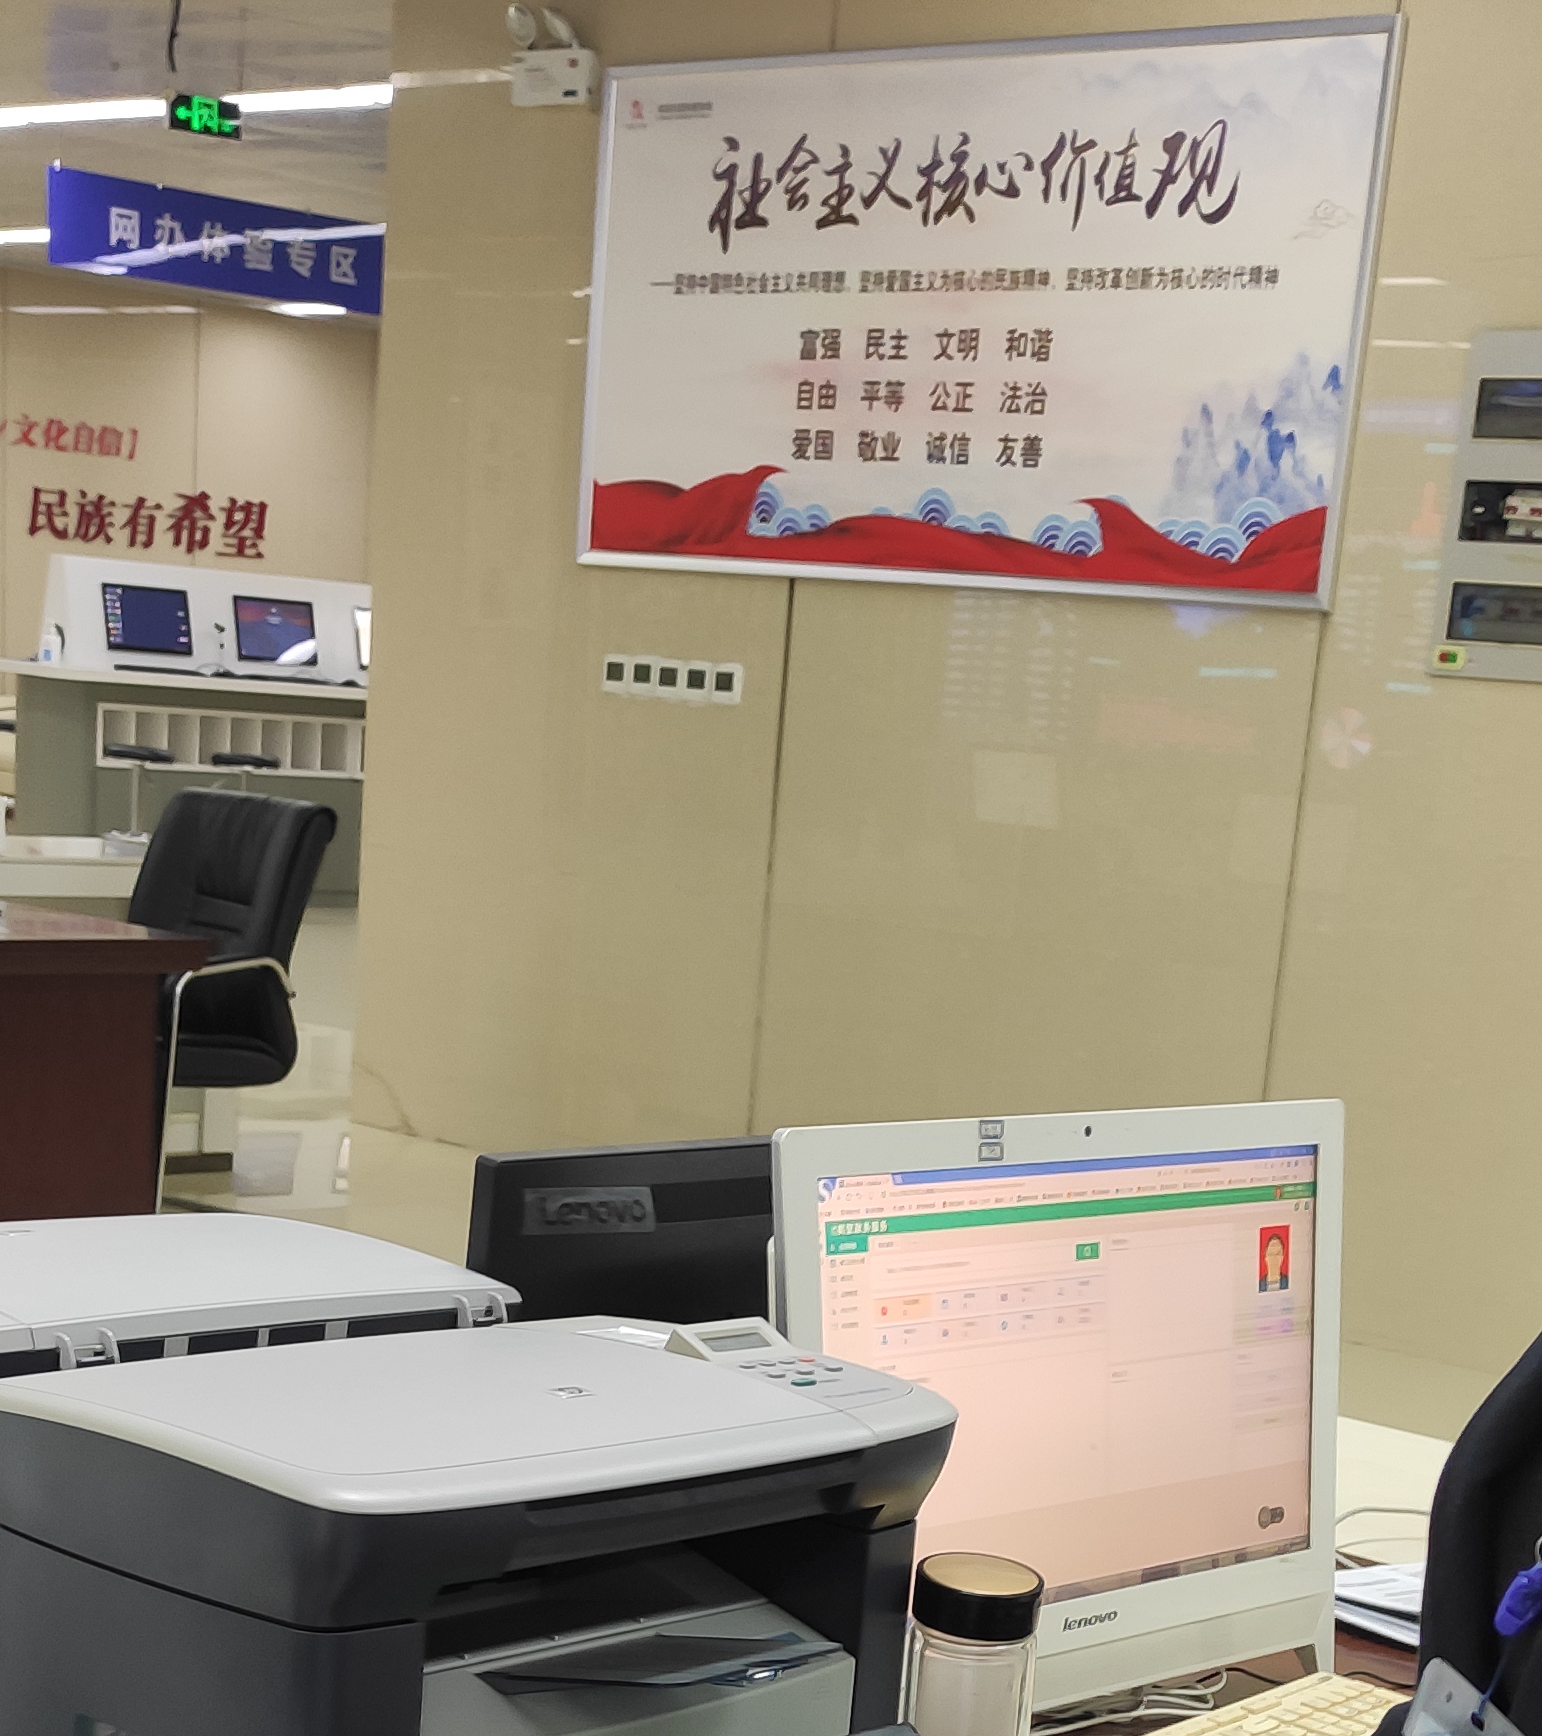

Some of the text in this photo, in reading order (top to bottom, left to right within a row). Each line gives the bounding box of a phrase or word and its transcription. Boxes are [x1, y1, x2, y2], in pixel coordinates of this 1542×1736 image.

[800, 327, 1055, 363] 富强 民主 文明 和谐
[796, 377, 1048, 416] 自由 平等 公正 法治
[792, 428, 1044, 469] 爱国 敬业 诚信 友善
[27, 485, 269, 560] 民族有希望
